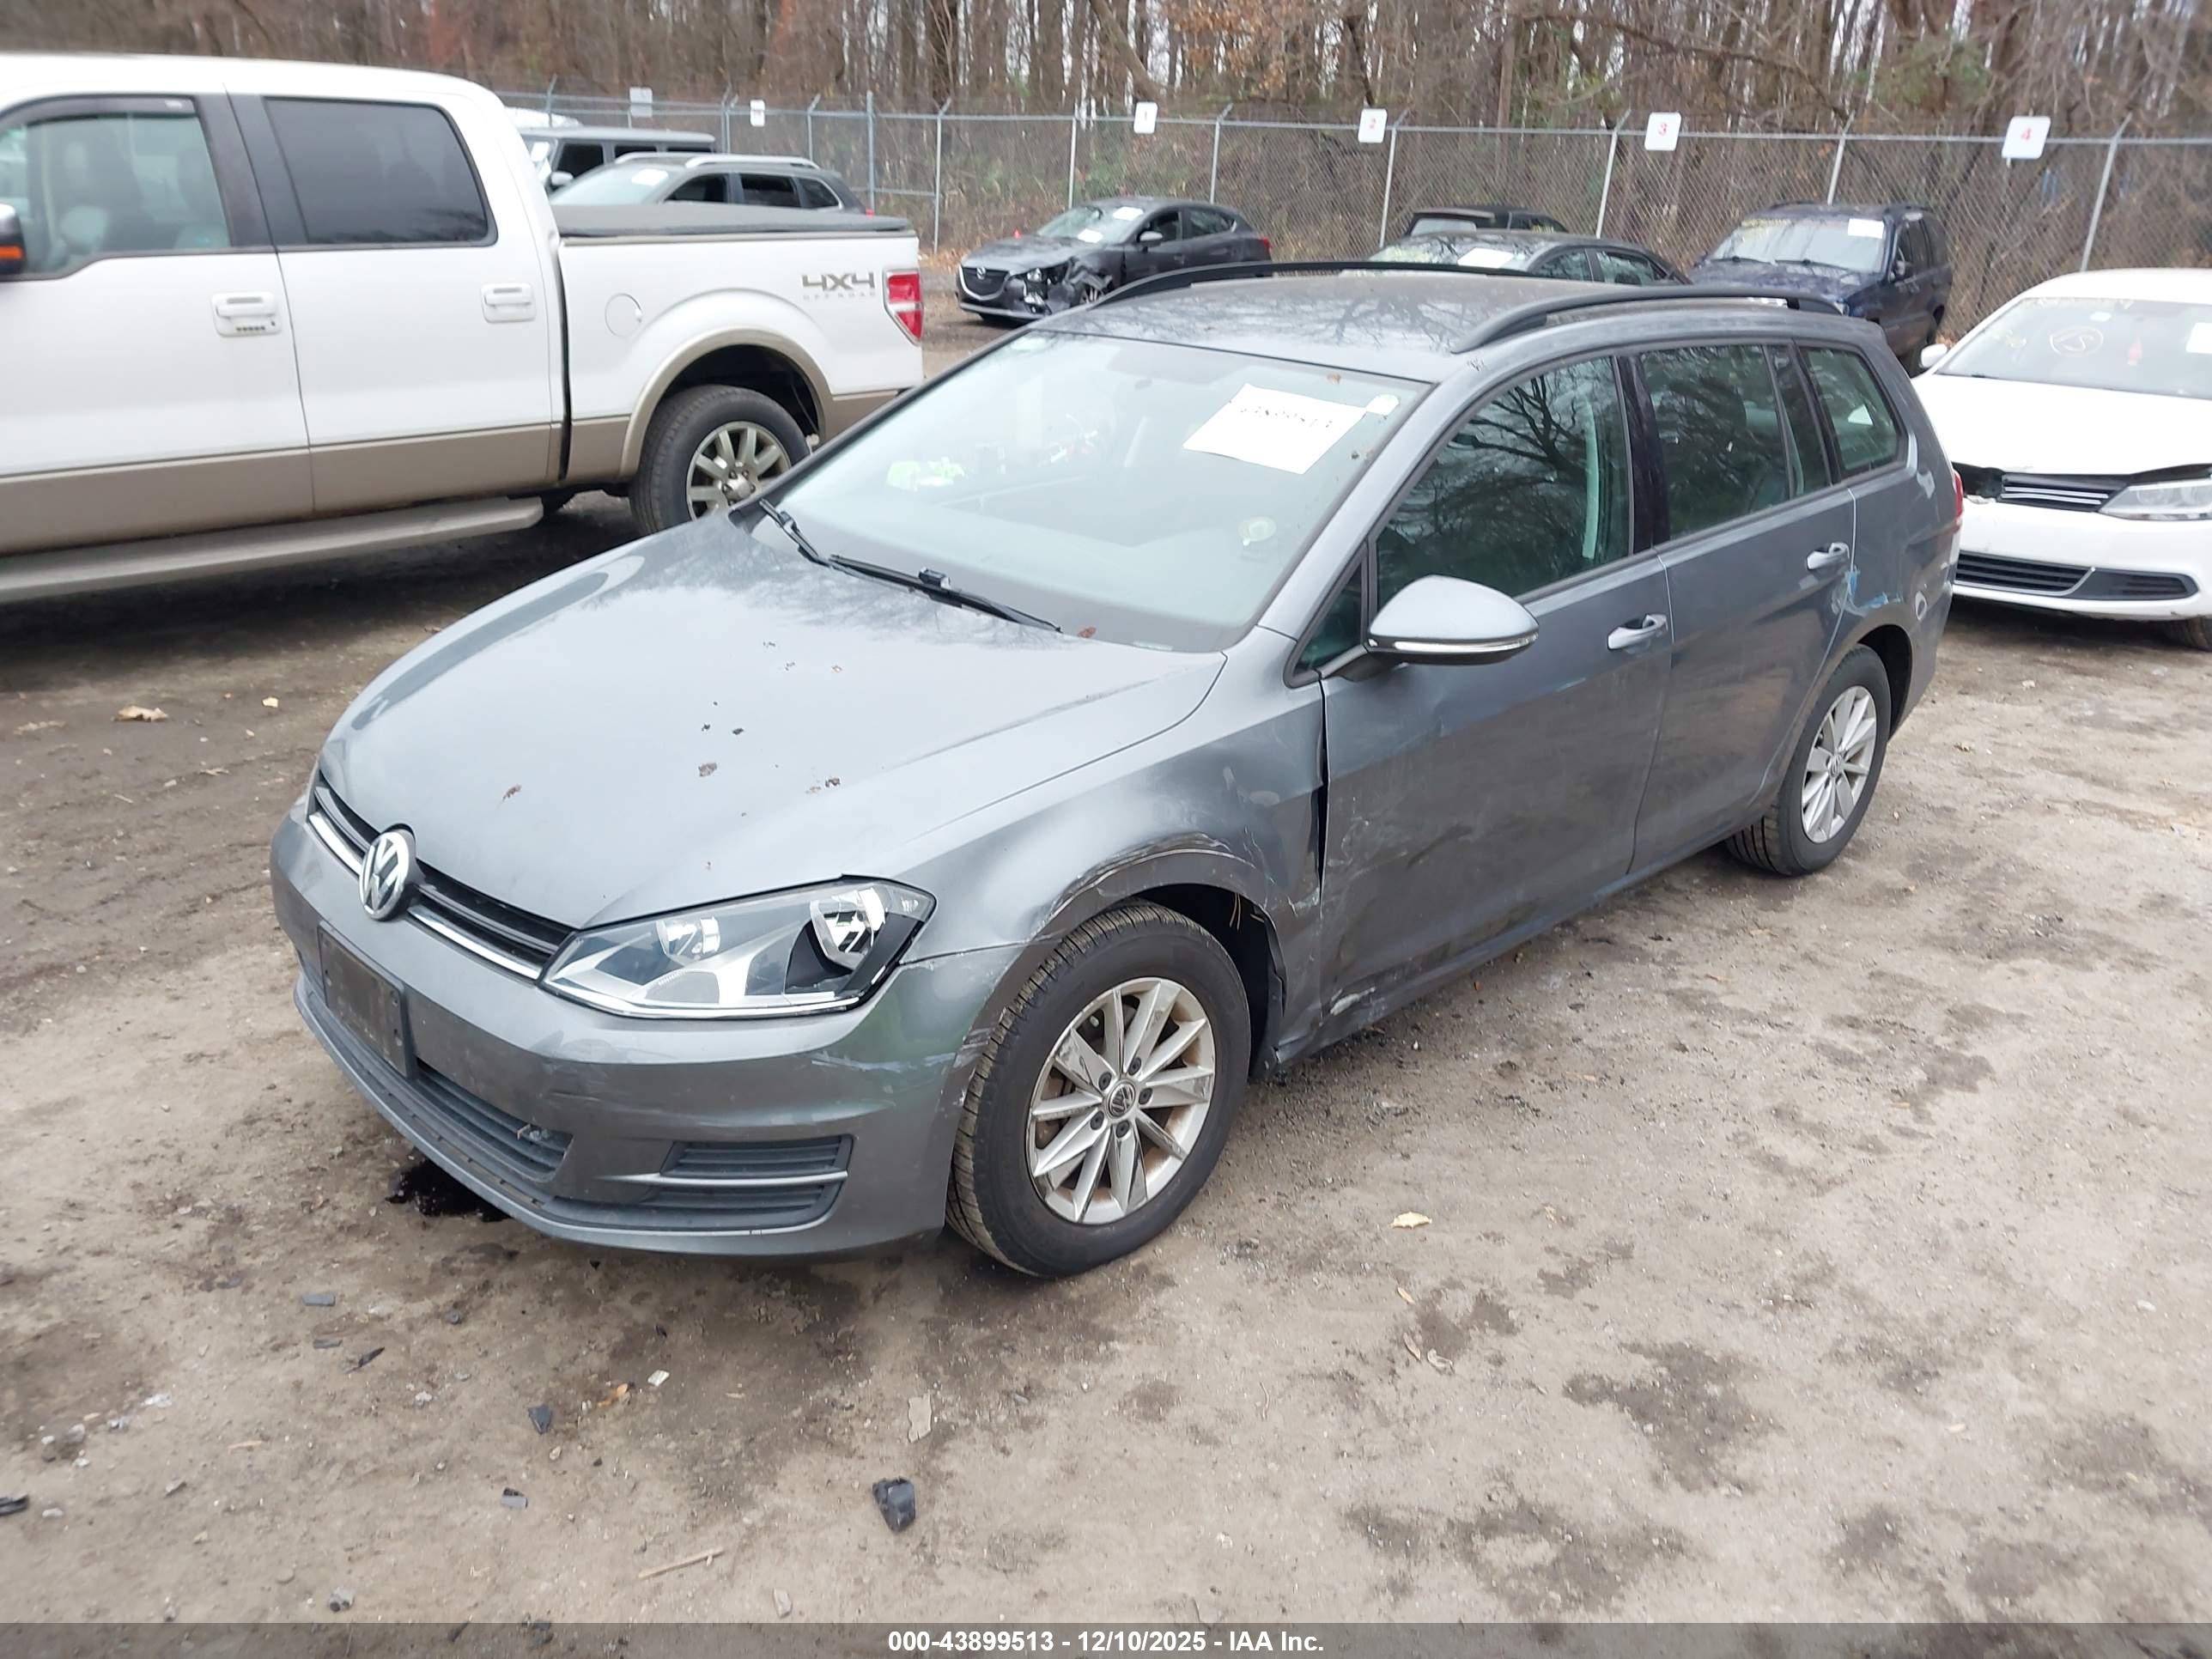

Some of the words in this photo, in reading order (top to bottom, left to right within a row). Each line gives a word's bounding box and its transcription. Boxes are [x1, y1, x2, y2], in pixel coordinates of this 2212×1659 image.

[1657, 123, 1668, 137] 3
[2020, 127, 2033, 141] 4
[802, 271, 875, 292] 4X4
